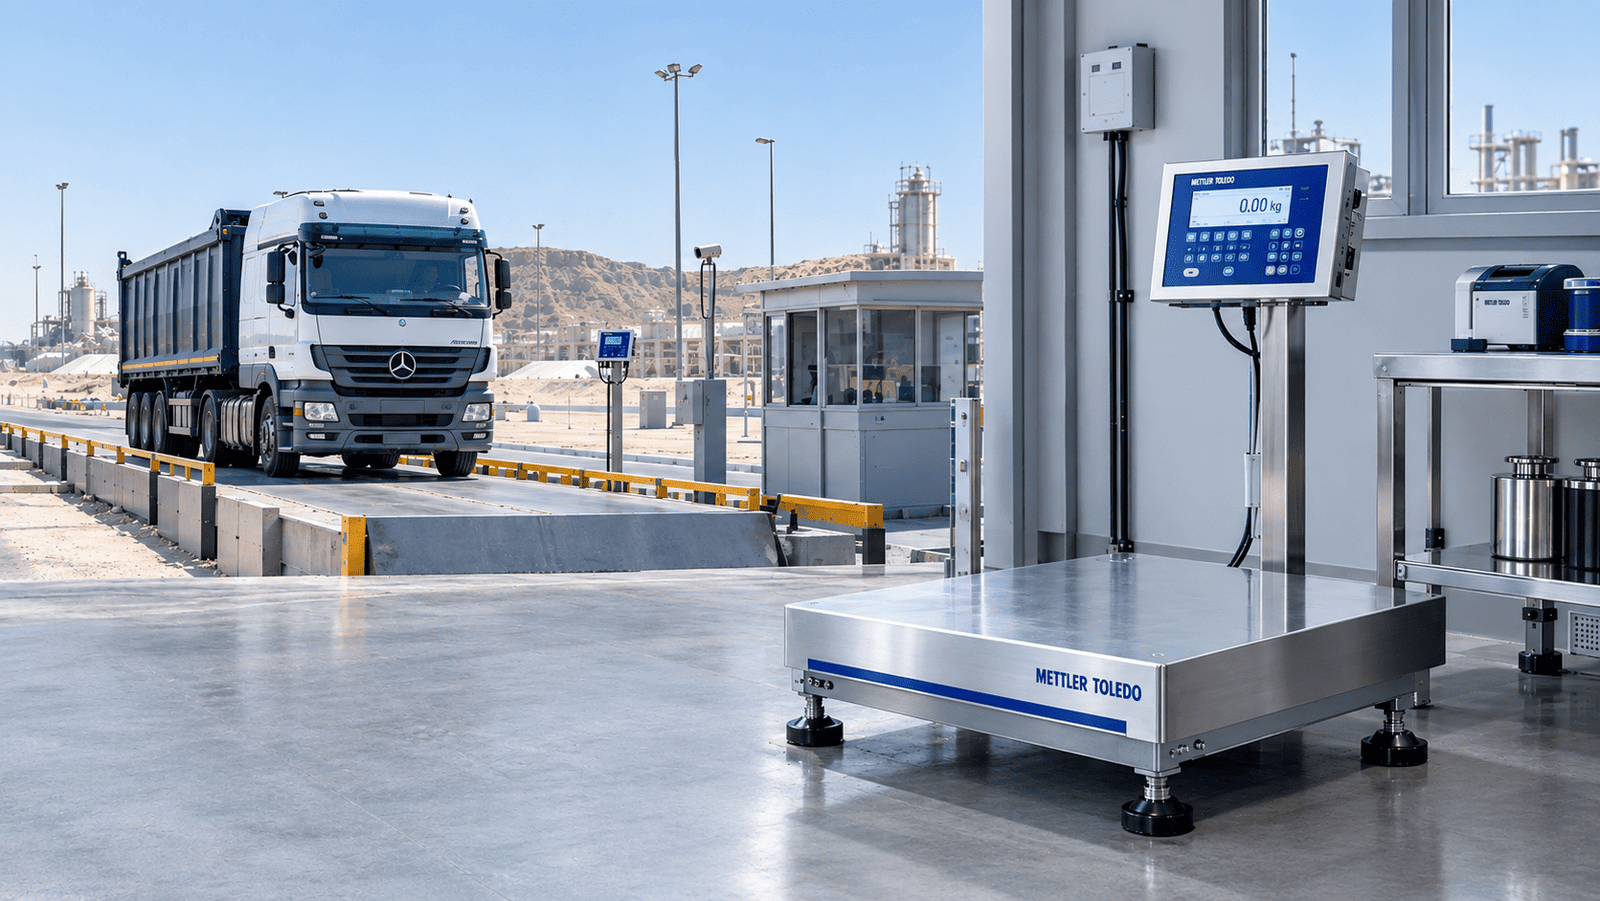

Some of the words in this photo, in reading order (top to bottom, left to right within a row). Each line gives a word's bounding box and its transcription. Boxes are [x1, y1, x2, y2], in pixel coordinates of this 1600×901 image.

[1240, 197, 1268, 213] 0.00
[1270, 200, 1282, 213] kg
[1036, 667, 1088, 692] METTLER
[1092, 677, 1142, 702] TOLEDO
